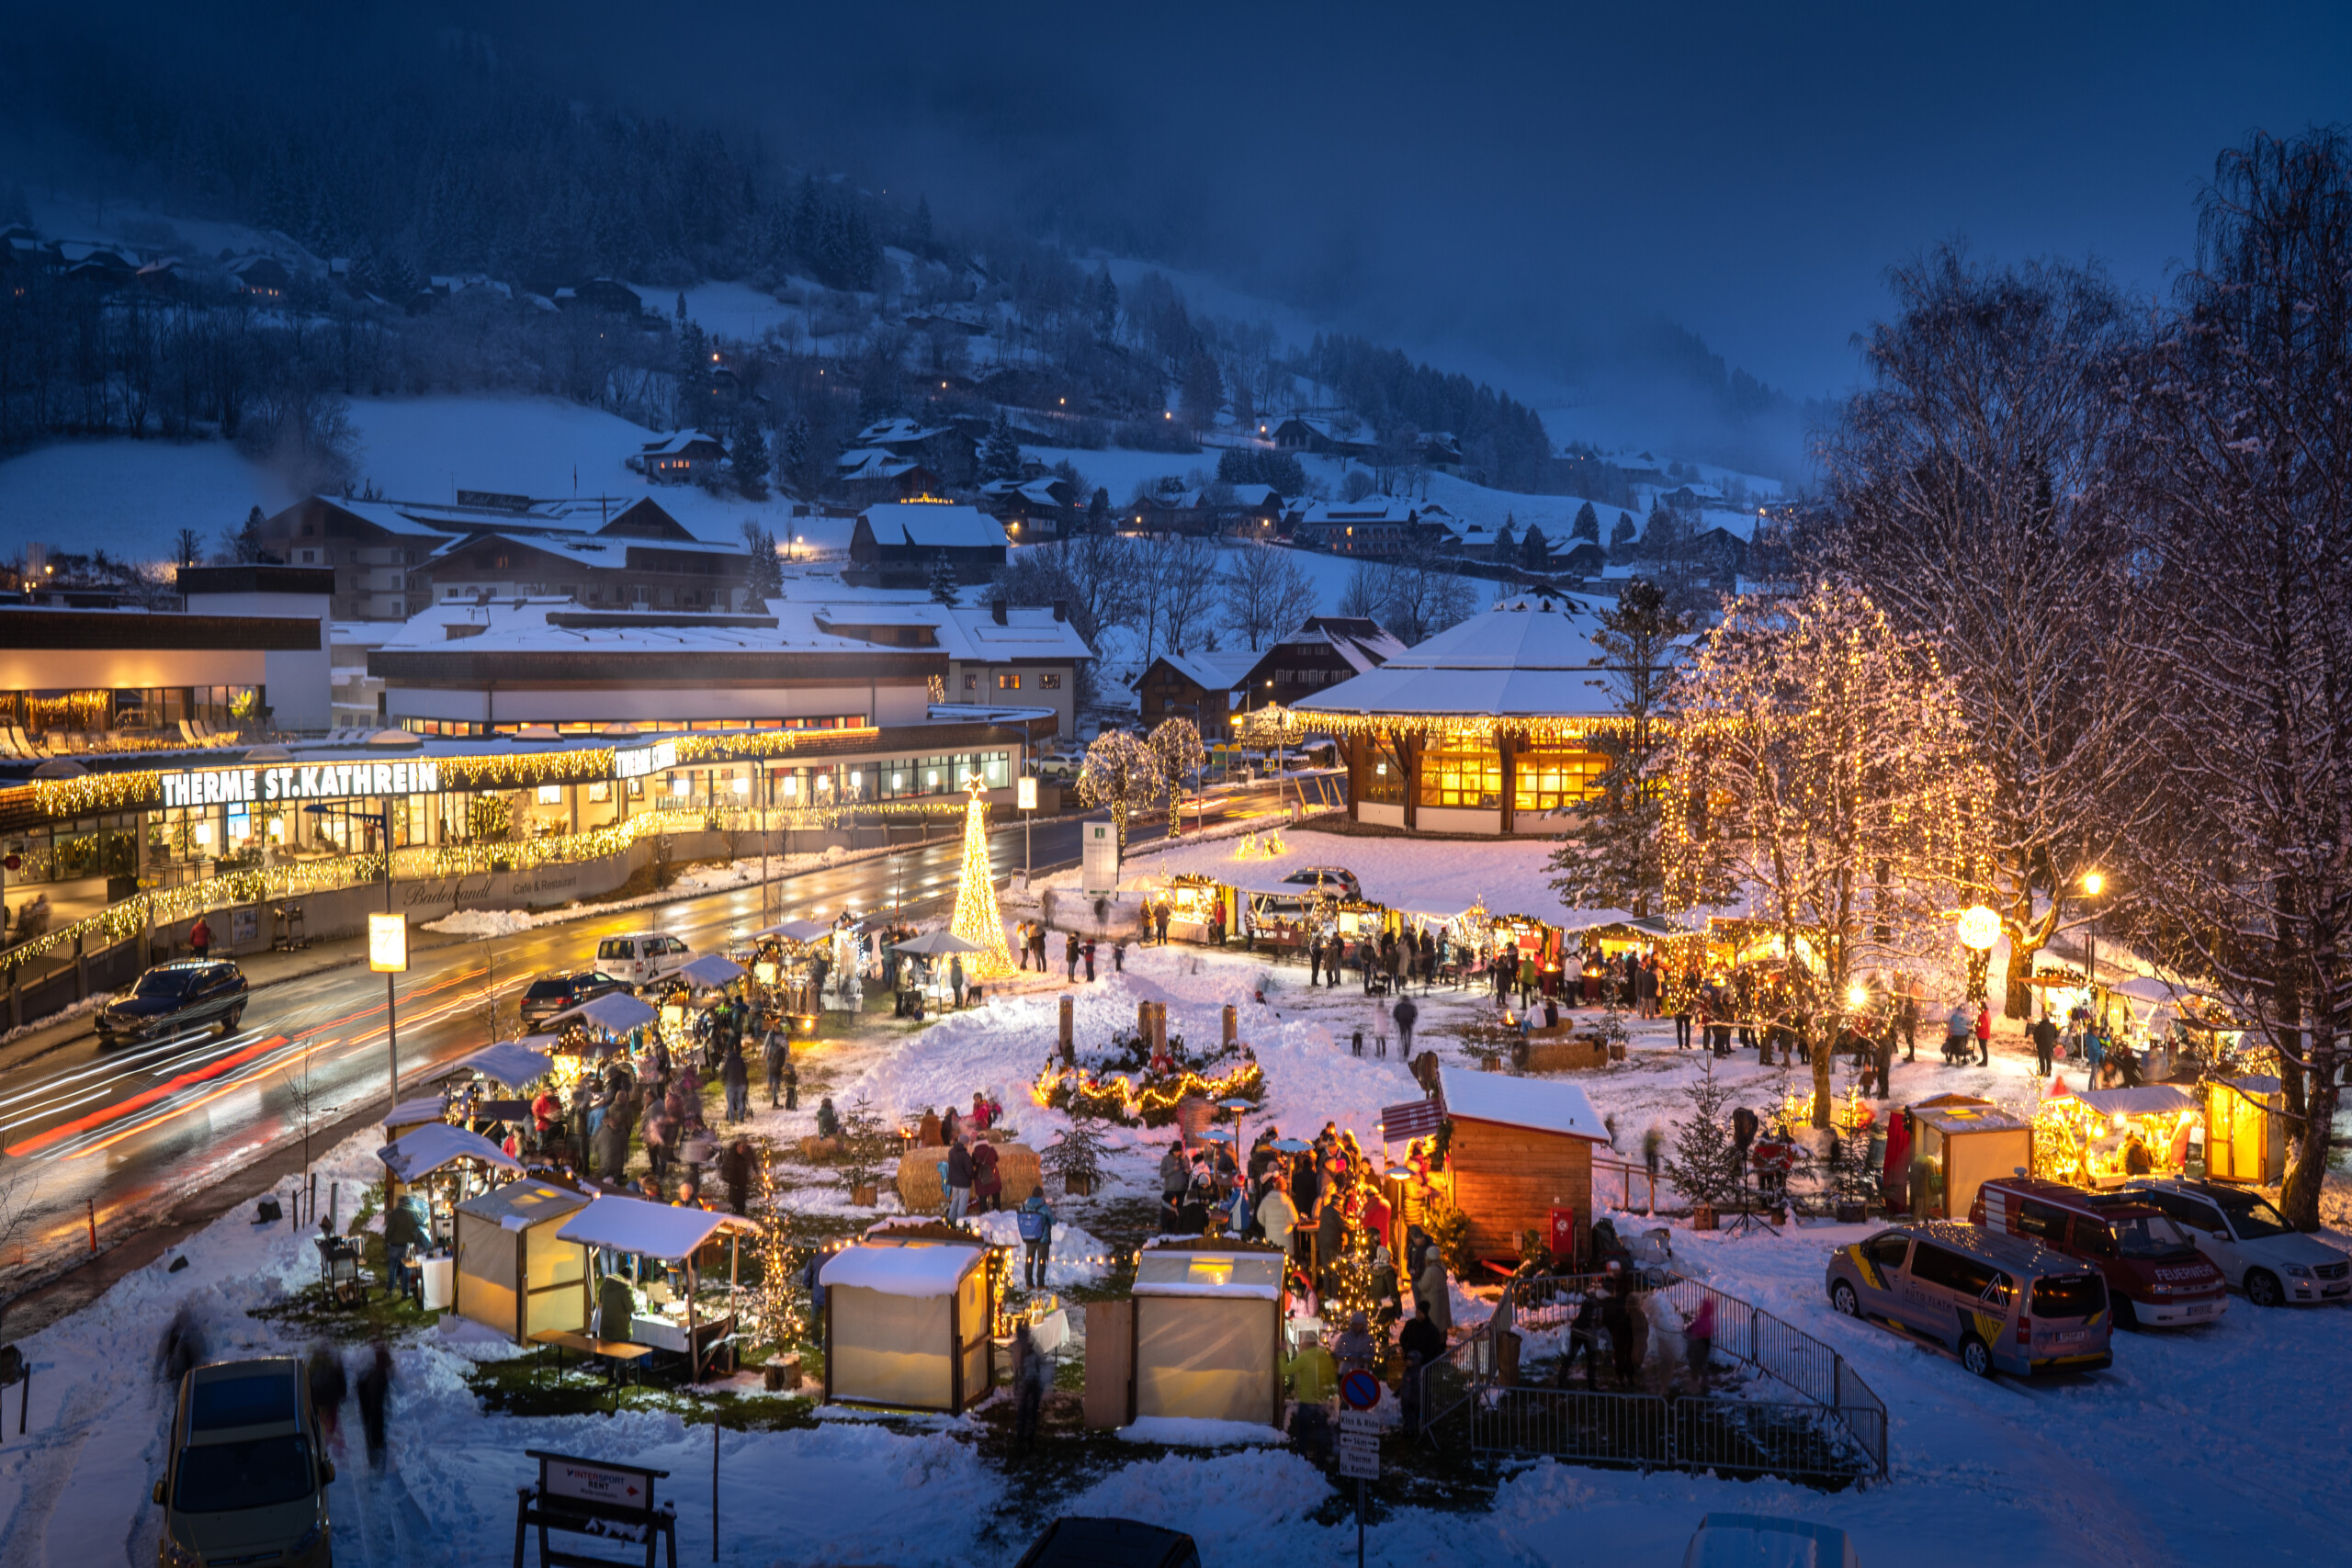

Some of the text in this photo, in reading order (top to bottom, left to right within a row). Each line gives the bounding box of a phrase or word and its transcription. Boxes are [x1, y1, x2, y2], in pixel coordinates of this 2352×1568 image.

[163, 770, 256, 807] THERME
[513, 875, 577, 896] Café & Restaurant
[2154, 1264, 2219, 1280] FEUERWEHR
[1905, 1287, 1926, 1301] AUTO
[1341, 1417, 1354, 1426] Kiss
[1364, 1419, 1379, 1428] Ride
[1354, 1438, 1367, 1446] 14m
[1348, 1454, 1372, 1463] Therme
[1351, 1466, 1379, 1476] Kathrein
[574, 1471, 625, 1484] INTERSPORT
[588, 1481, 610, 1490] RENT
